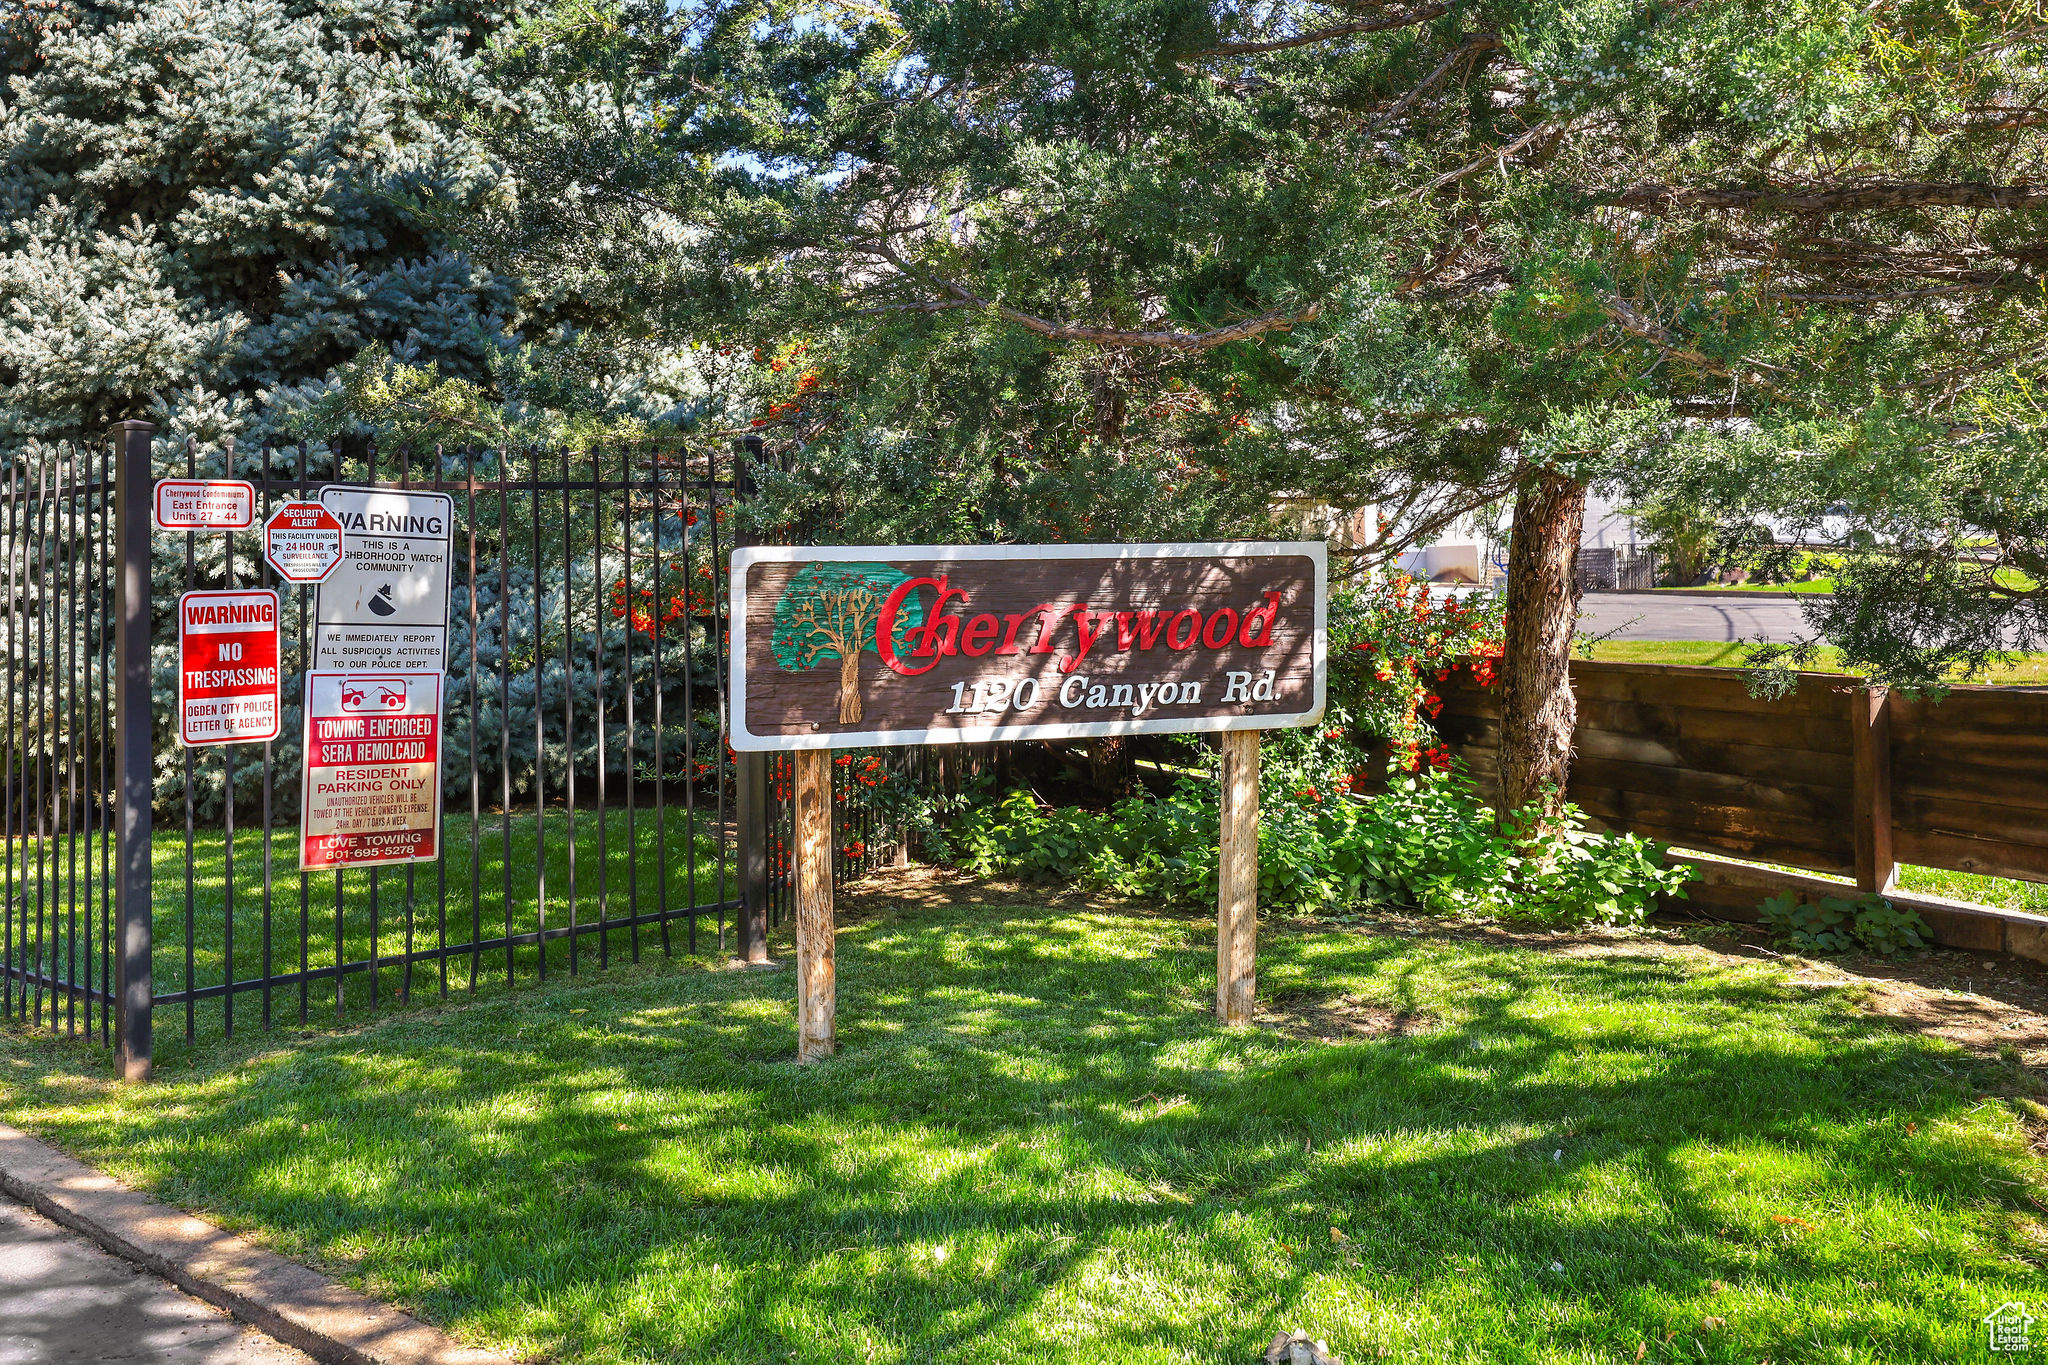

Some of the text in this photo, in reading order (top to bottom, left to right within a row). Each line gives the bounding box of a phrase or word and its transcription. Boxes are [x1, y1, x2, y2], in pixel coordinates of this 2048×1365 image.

[165, 488, 245, 499] Cherrywood Condominiums
[172, 500, 238, 510] East Entrance
[172, 511, 197, 521] Units
[200, 511, 213, 521] 27
[224, 511, 238, 521] 44
[283, 508, 325, 518] SECURITY
[291, 518, 318, 527] ALERT
[331, 511, 443, 535] WARNING
[271, 532, 338, 540] THIS FACILITY UNDER
[285, 542, 325, 551] 24 HOUR
[362, 540, 410, 551] THIS IS A
[282, 552, 329, 560] SURVEILLANCE
[345, 550, 443, 563] GHBORHOOD WATCH
[356, 562, 414, 573] COMMUNITY
[187, 604, 273, 625] WARNING
[875, 574, 1282, 677] Cherrywood
[327, 633, 436, 643] WE IMMEDIATELY REPORT
[218, 642, 243, 662] NO
[320, 647, 441, 656] ALL SUSPICIOUS ACTIVITIES
[333, 660, 428, 669] TO OUR POLICE DEPT.
[185, 667, 276, 690] TRESPASSING
[945, 670, 1283, 717] 1120 Canyon Rd.
[187, 700, 273, 718] OGDEN CITY POLICE
[187, 715, 273, 733] LETTER OF AGENCY
[316, 717, 433, 740] TOWING ENFORCED
[321, 740, 427, 764] SERA REMOLCADO
[335, 767, 410, 782] RESIDENT
[317, 778, 427, 795] PARKING ONLY
[326, 792, 417, 807] UNAUTHORIZED VEHICLES WILL BE
[313, 808, 333, 820] TOWED
[334, 807, 341, 818] AT
[342, 806, 353, 817] THE
[354, 806, 377, 817] VEHICLE
[378, 804, 403, 816] OWNER'S
[352, 818, 362, 829] DAY
[367, 817, 371, 828] 7
[371, 816, 385, 828] DAYS
[386, 816, 391, 827] A
[392, 815, 407, 826] WEEK
[319, 833, 422, 850] LOVE TOWING
[325, 845, 415, 861] 801-695-5278
